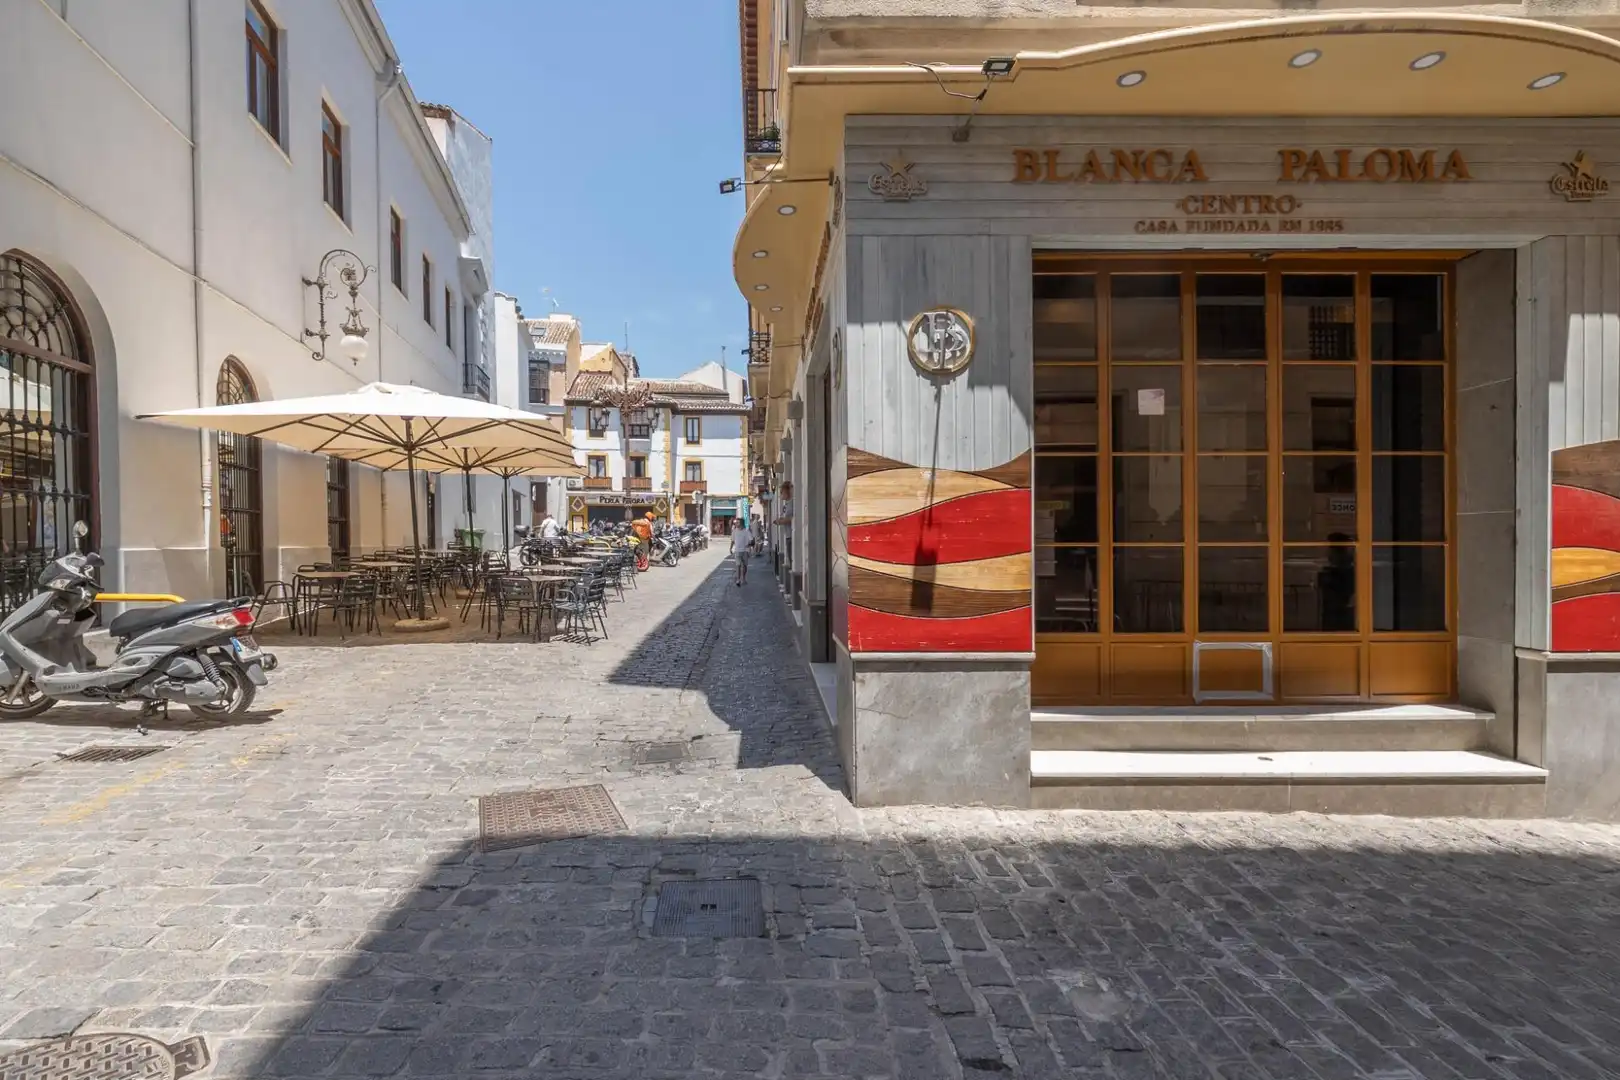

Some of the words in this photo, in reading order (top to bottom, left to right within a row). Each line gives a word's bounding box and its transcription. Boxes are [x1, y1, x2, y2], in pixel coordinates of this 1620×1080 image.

[1012, 148, 1208, 184] BLANCA
[1278, 148, 1474, 183] PALOMA
[1134, 220, 1179, 234] CASA
[1186, 220, 1271, 234] FUNDADA
